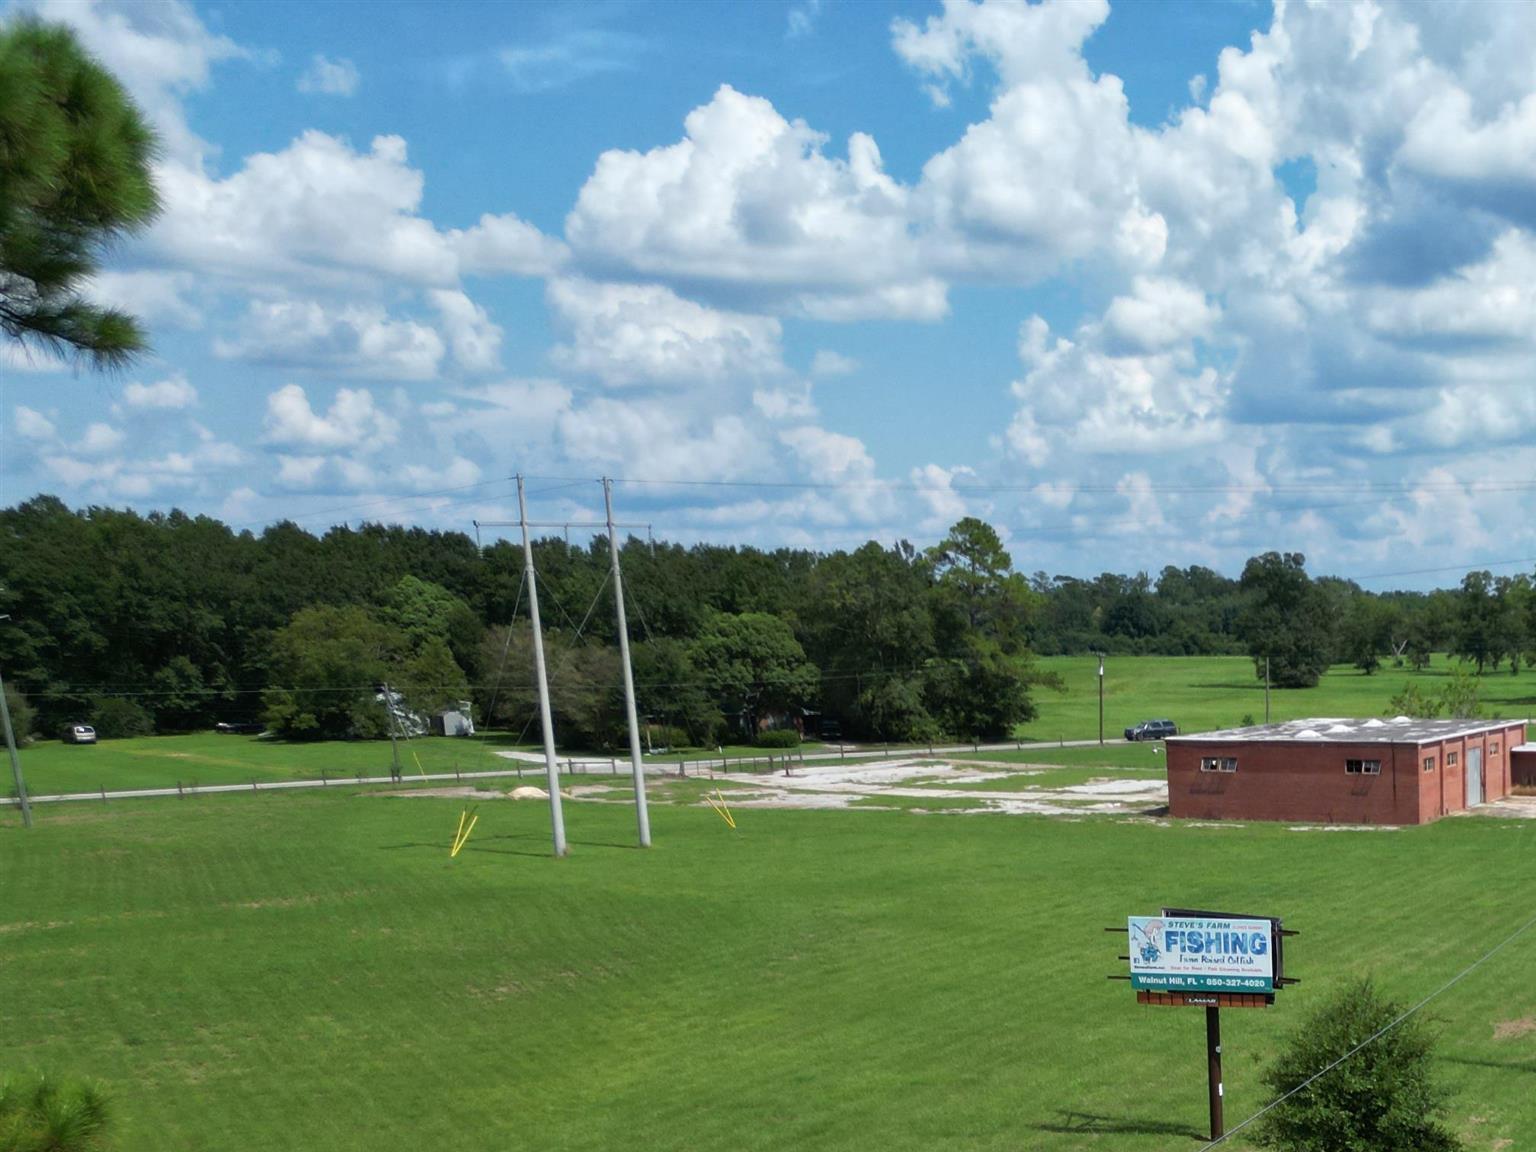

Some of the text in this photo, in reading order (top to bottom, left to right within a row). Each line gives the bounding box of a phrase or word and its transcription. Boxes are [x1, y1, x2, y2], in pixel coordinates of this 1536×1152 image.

[1168, 921, 1204, 929] STEVE'S
[1207, 922, 1231, 930] FARM
[1165, 930, 1267, 955] FISHING
[1138, 976, 1167, 985] Walnut
[1169, 977, 1185, 986] Hill,
[1187, 978, 1198, 986] FL
